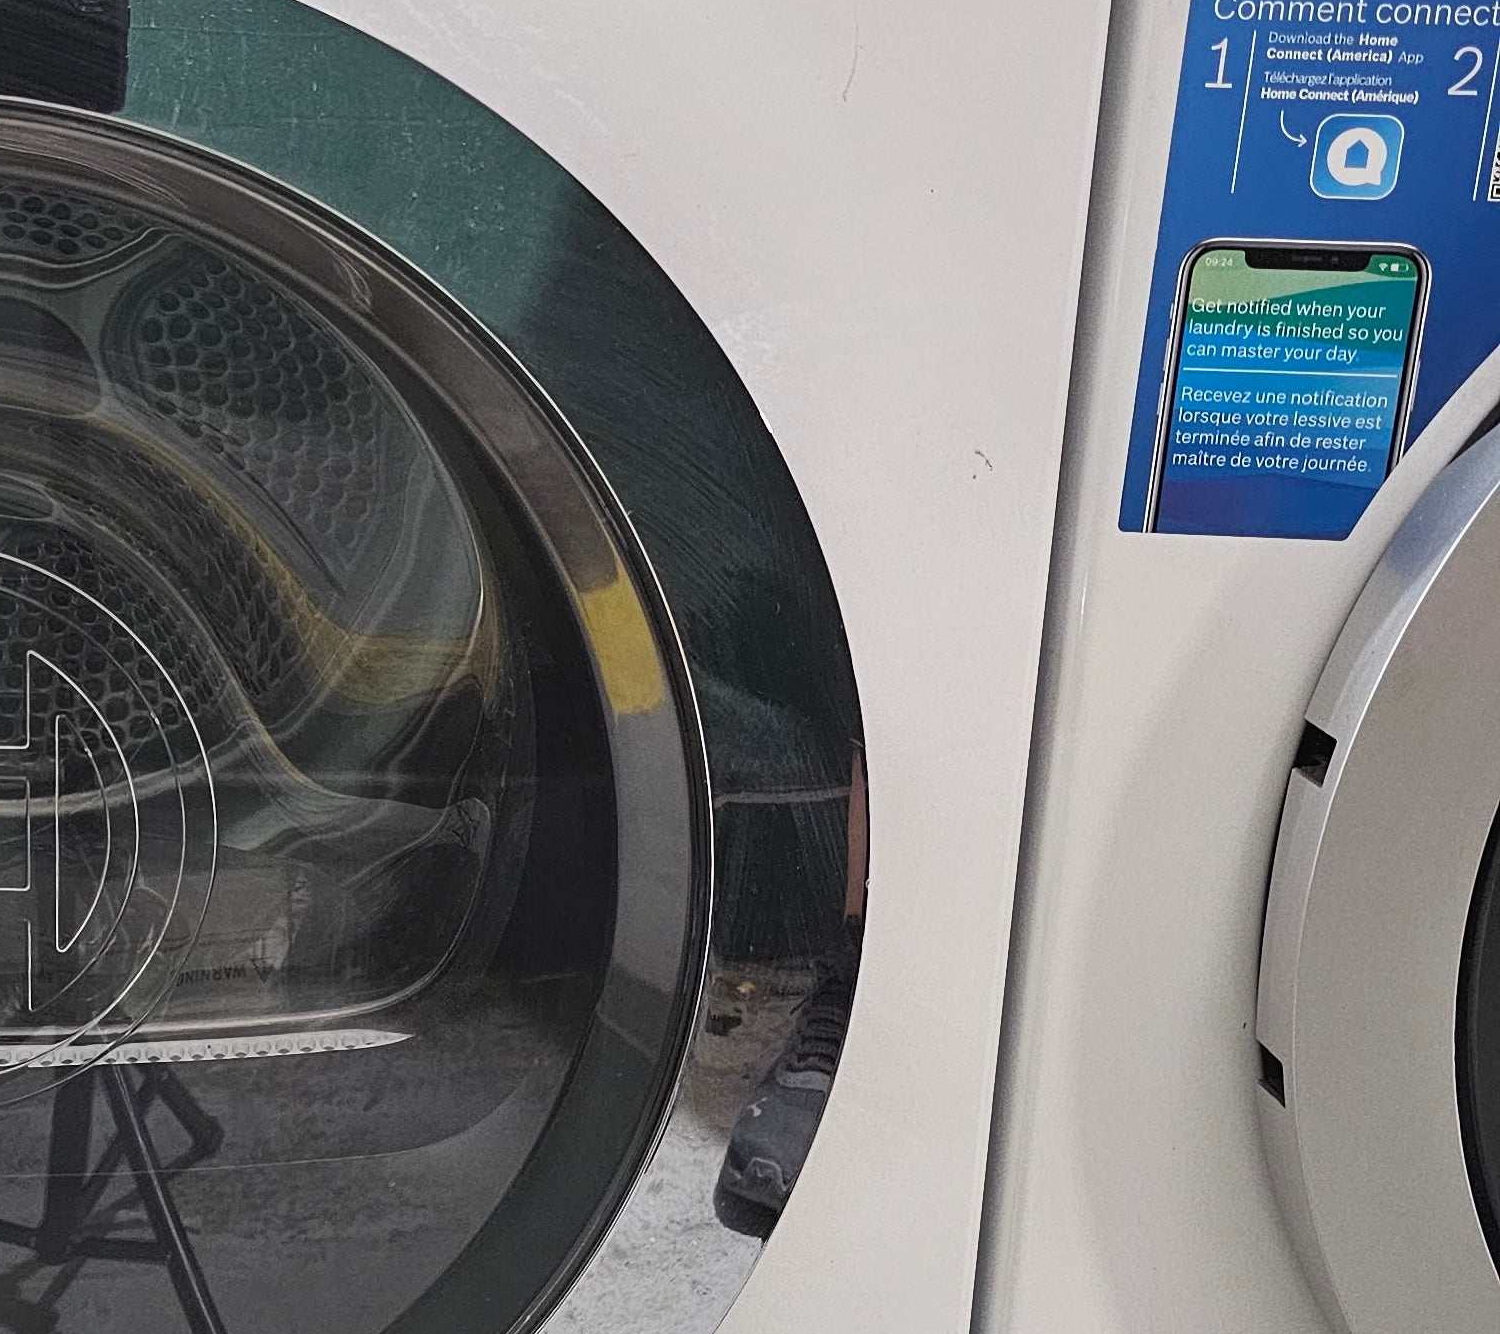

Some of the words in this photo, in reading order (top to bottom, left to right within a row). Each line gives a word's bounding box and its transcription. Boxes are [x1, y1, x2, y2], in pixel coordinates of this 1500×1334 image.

[1268, 30, 1332, 46] Download
[1334, 32, 1354, 46] the
[1358, 33, 1399, 47] Home
[1204, 37, 1233, 90] 1
[1266, 48, 1323, 61] Connect
[1326, 48, 1393, 64] (America)
[1398, 51, 1424, 65] App
[1447, 46, 1483, 96] 2
[1260, 88, 1297, 100] Home
[1298, 89, 1349, 102] Connect
[1351, 88, 1420, 105] (Amérique)
[1205, 256, 1233, 267] 09:24
[1191, 298, 1222, 314] Get
[1226, 299, 1292, 316] notified
[1296, 301, 1343, 317] when
[1346, 305, 1386, 322] your
[1188, 319, 1253, 340] laundry
[1257, 322, 1271, 337] is
[1276, 322, 1343, 340] finished
[1347, 327, 1369, 340] so
[1372, 328, 1403, 344] you
[1186, 344, 1216, 357] can
[1221, 345, 1280, 359] master
[1283, 348, 1323, 364] your
[1326, 346, 1360, 364] day.
[1181, 386, 1251, 403] Recevez
[1255, 392, 1287, 405] une
[1291, 389, 1388, 408] notification
[1178, 407, 1241, 426] lorsque
[1245, 412, 1289, 427] votre
[1293, 413, 1352, 429] lessive
[1355, 416, 1382, 430] est
[1175, 430, 1250, 446] terminée
[1254, 433, 1285, 448] afin
[1289, 434, 1311, 448] de
[1315, 437, 1366, 450] rester
[1172, 450, 1226, 465] maître
[1230, 452, 1251, 467] de
[1255, 454, 1299, 469] votre
[1301, 454, 1372, 473] journée.
